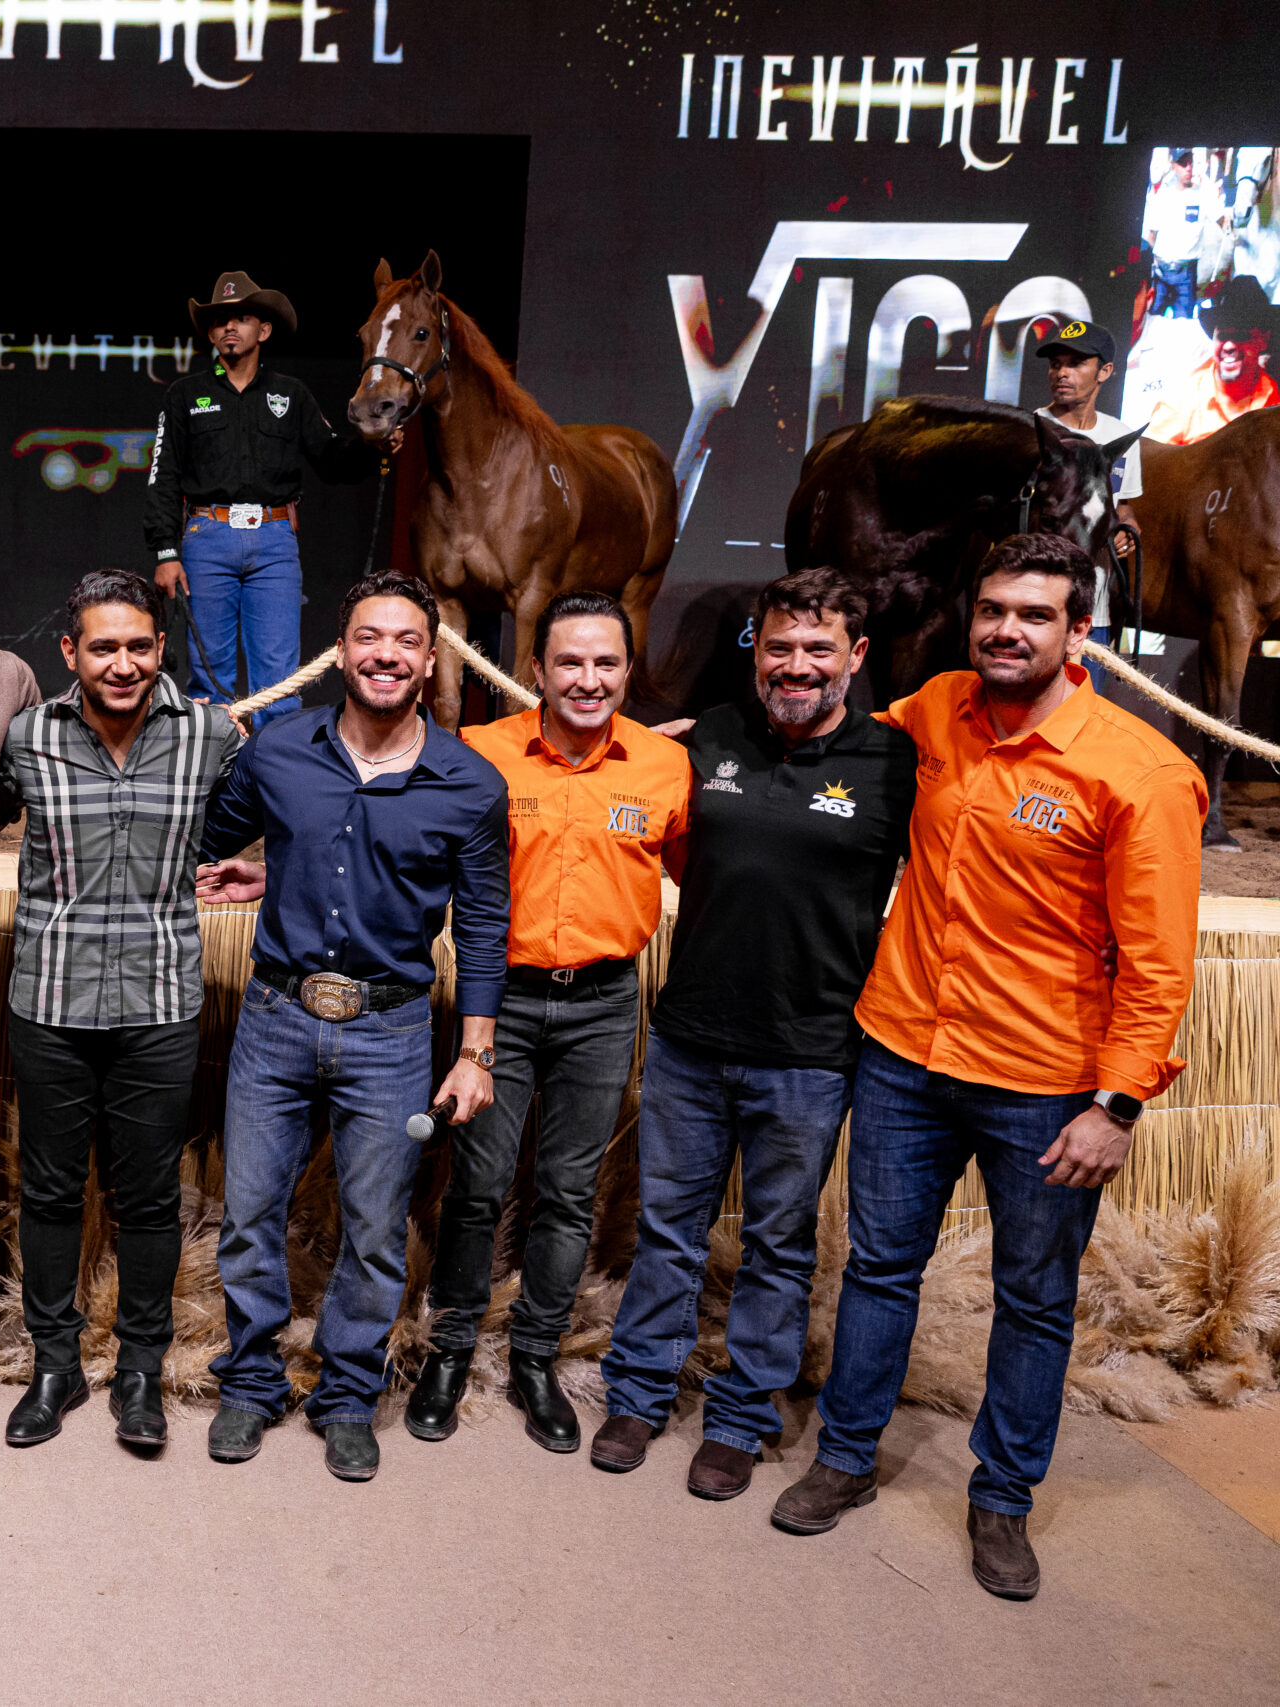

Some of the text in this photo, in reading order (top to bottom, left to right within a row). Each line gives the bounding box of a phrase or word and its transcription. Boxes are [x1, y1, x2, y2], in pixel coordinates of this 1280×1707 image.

[677, 43, 1128, 171] INEVITÁVEL
[607, 803, 649, 836] XJGC
[808, 794, 857, 818] 263
[1008, 793, 1067, 834] XJGC
